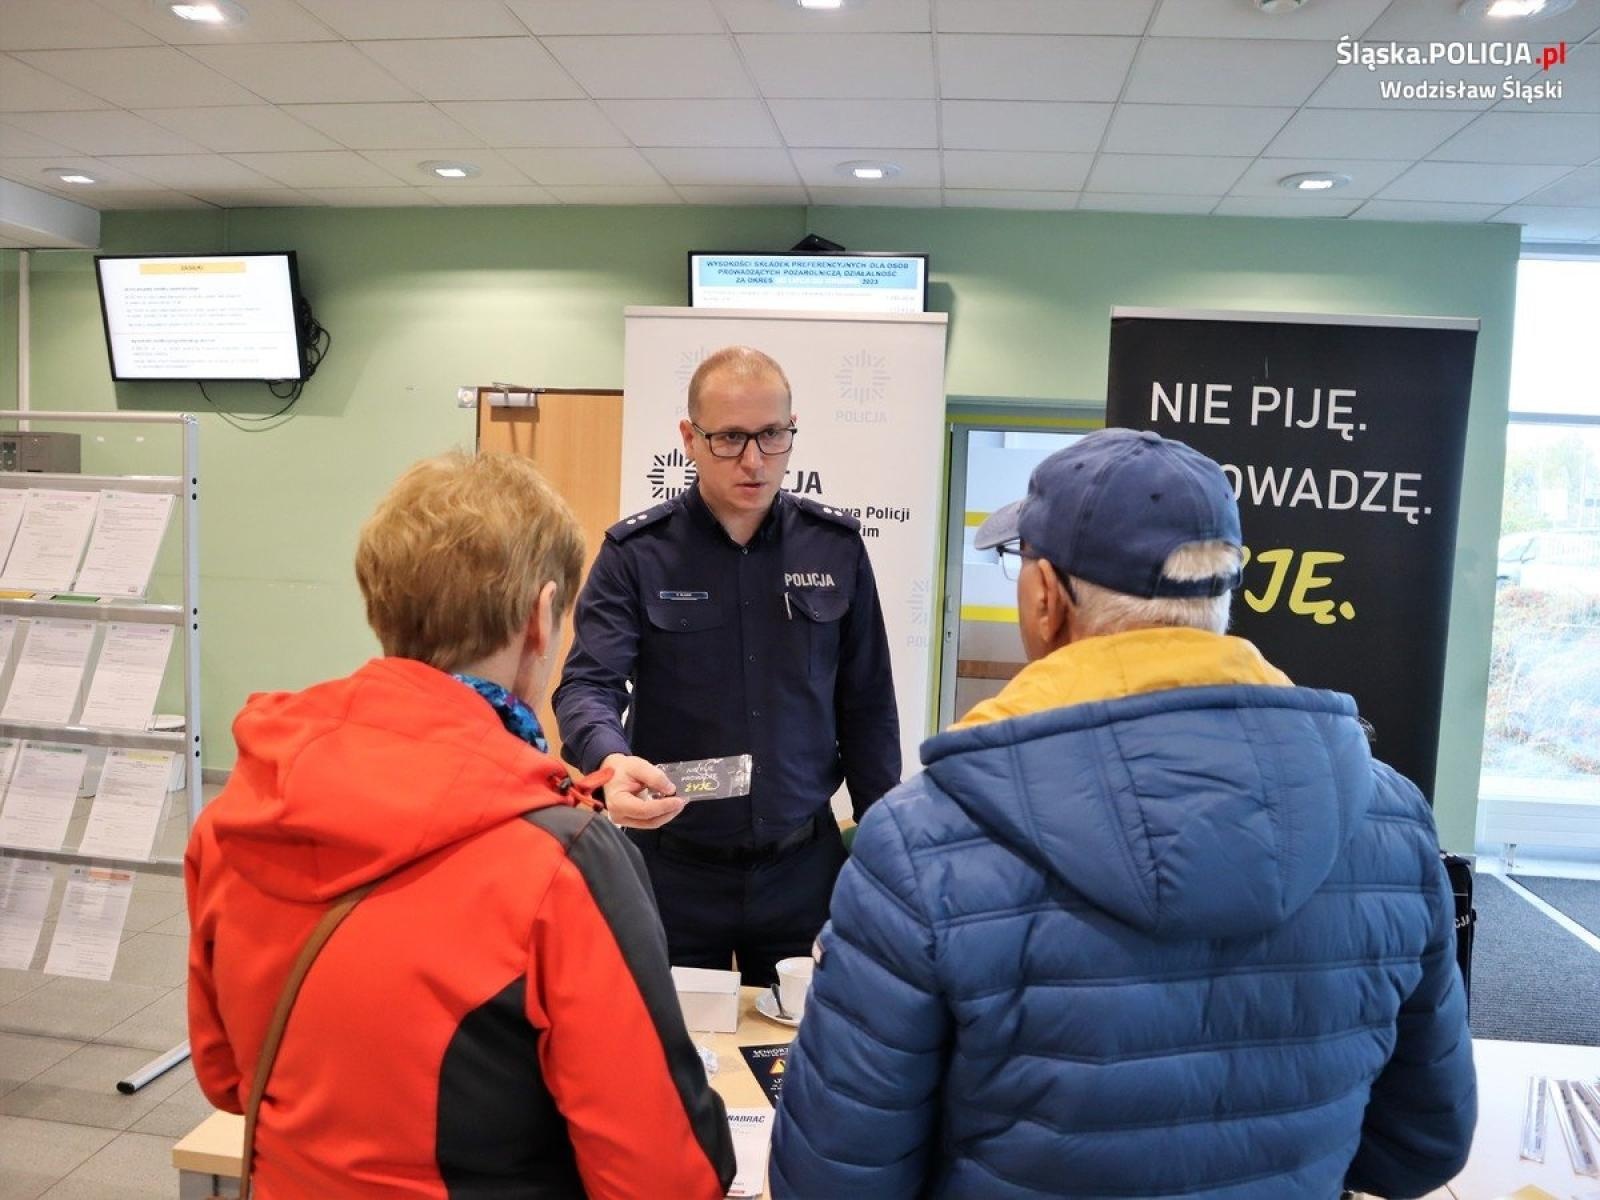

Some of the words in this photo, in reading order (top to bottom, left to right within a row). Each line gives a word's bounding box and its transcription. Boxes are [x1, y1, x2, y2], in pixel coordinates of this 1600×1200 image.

[835, 409, 888, 423] POLICJA
[1150, 382, 1233, 425] NIE
[1250, 386, 1367, 441] PIJĘ.
[866, 506, 910, 522] Policji
[784, 572, 836, 588] POLICJA
